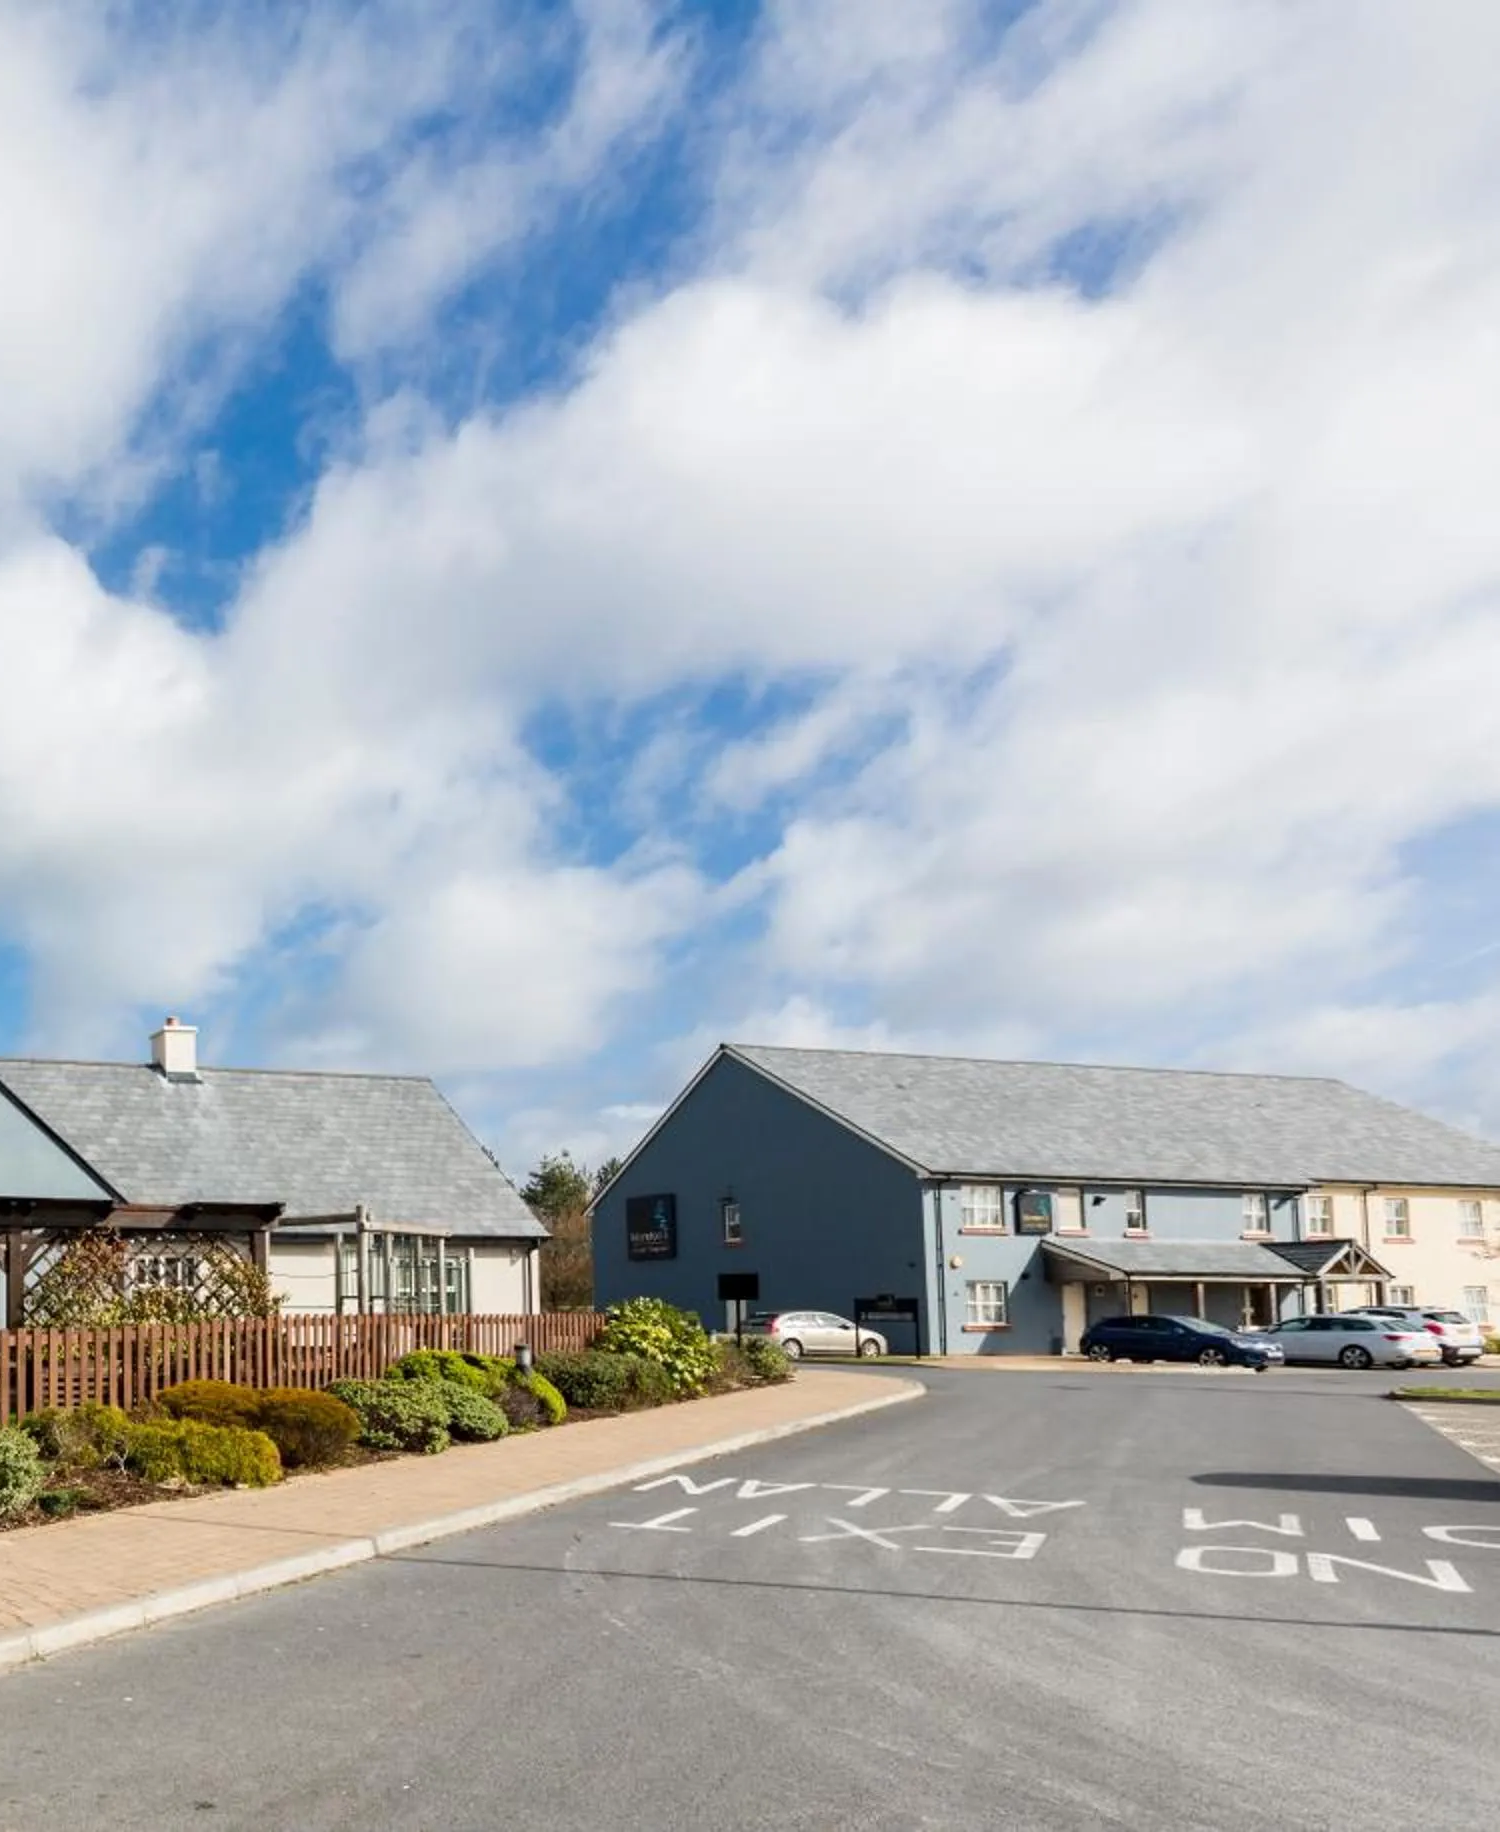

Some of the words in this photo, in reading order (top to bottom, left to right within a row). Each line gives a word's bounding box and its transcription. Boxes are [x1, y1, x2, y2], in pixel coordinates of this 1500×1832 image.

[632, 1473, 1087, 1519] ALLAN
[607, 1506, 1049, 1560] EXIT
[1174, 1544, 1476, 1594] NO
